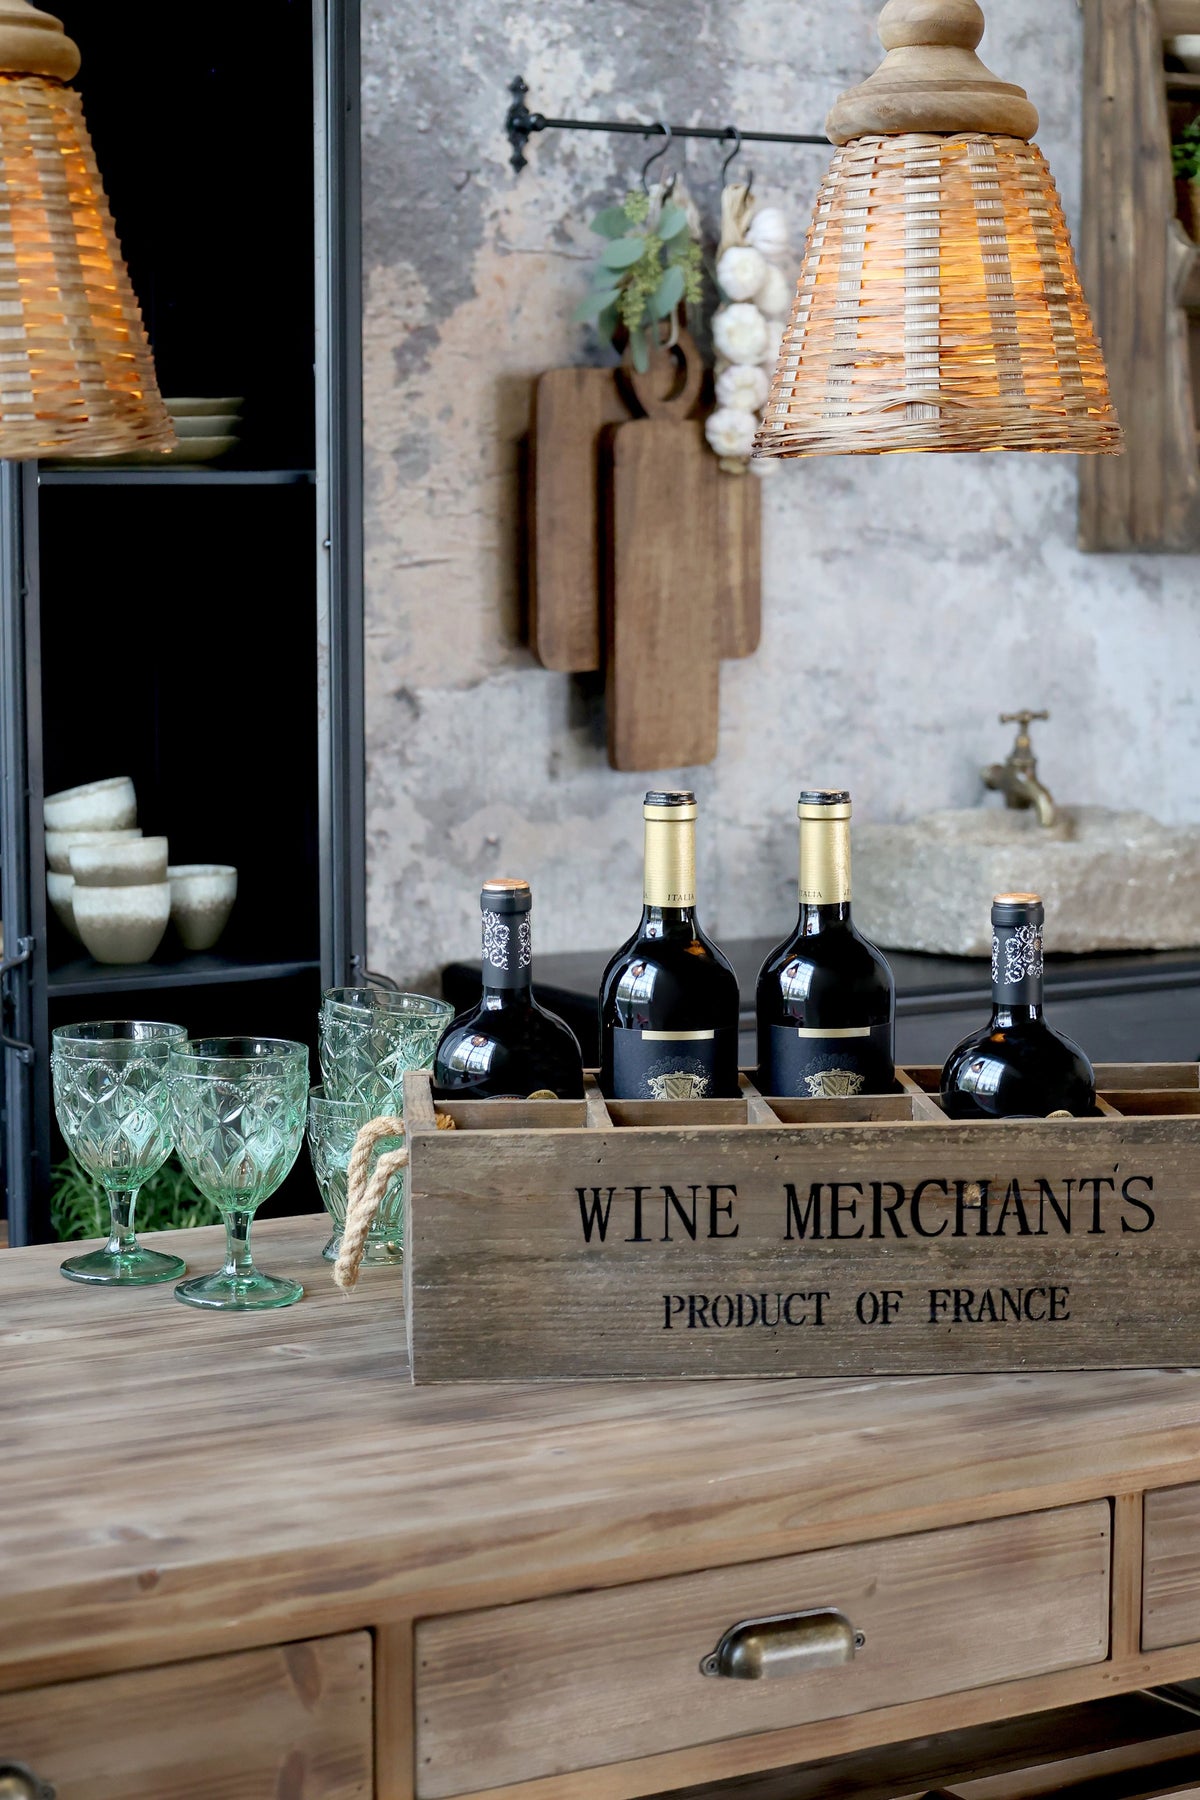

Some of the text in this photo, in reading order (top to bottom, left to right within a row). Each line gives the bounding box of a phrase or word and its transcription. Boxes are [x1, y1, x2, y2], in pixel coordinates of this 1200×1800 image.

[667, 893, 695, 902] ITALIA
[575, 1184, 739, 1243] WINE
[662, 1287, 1071, 1330] PRODUCT OF FRANCE
